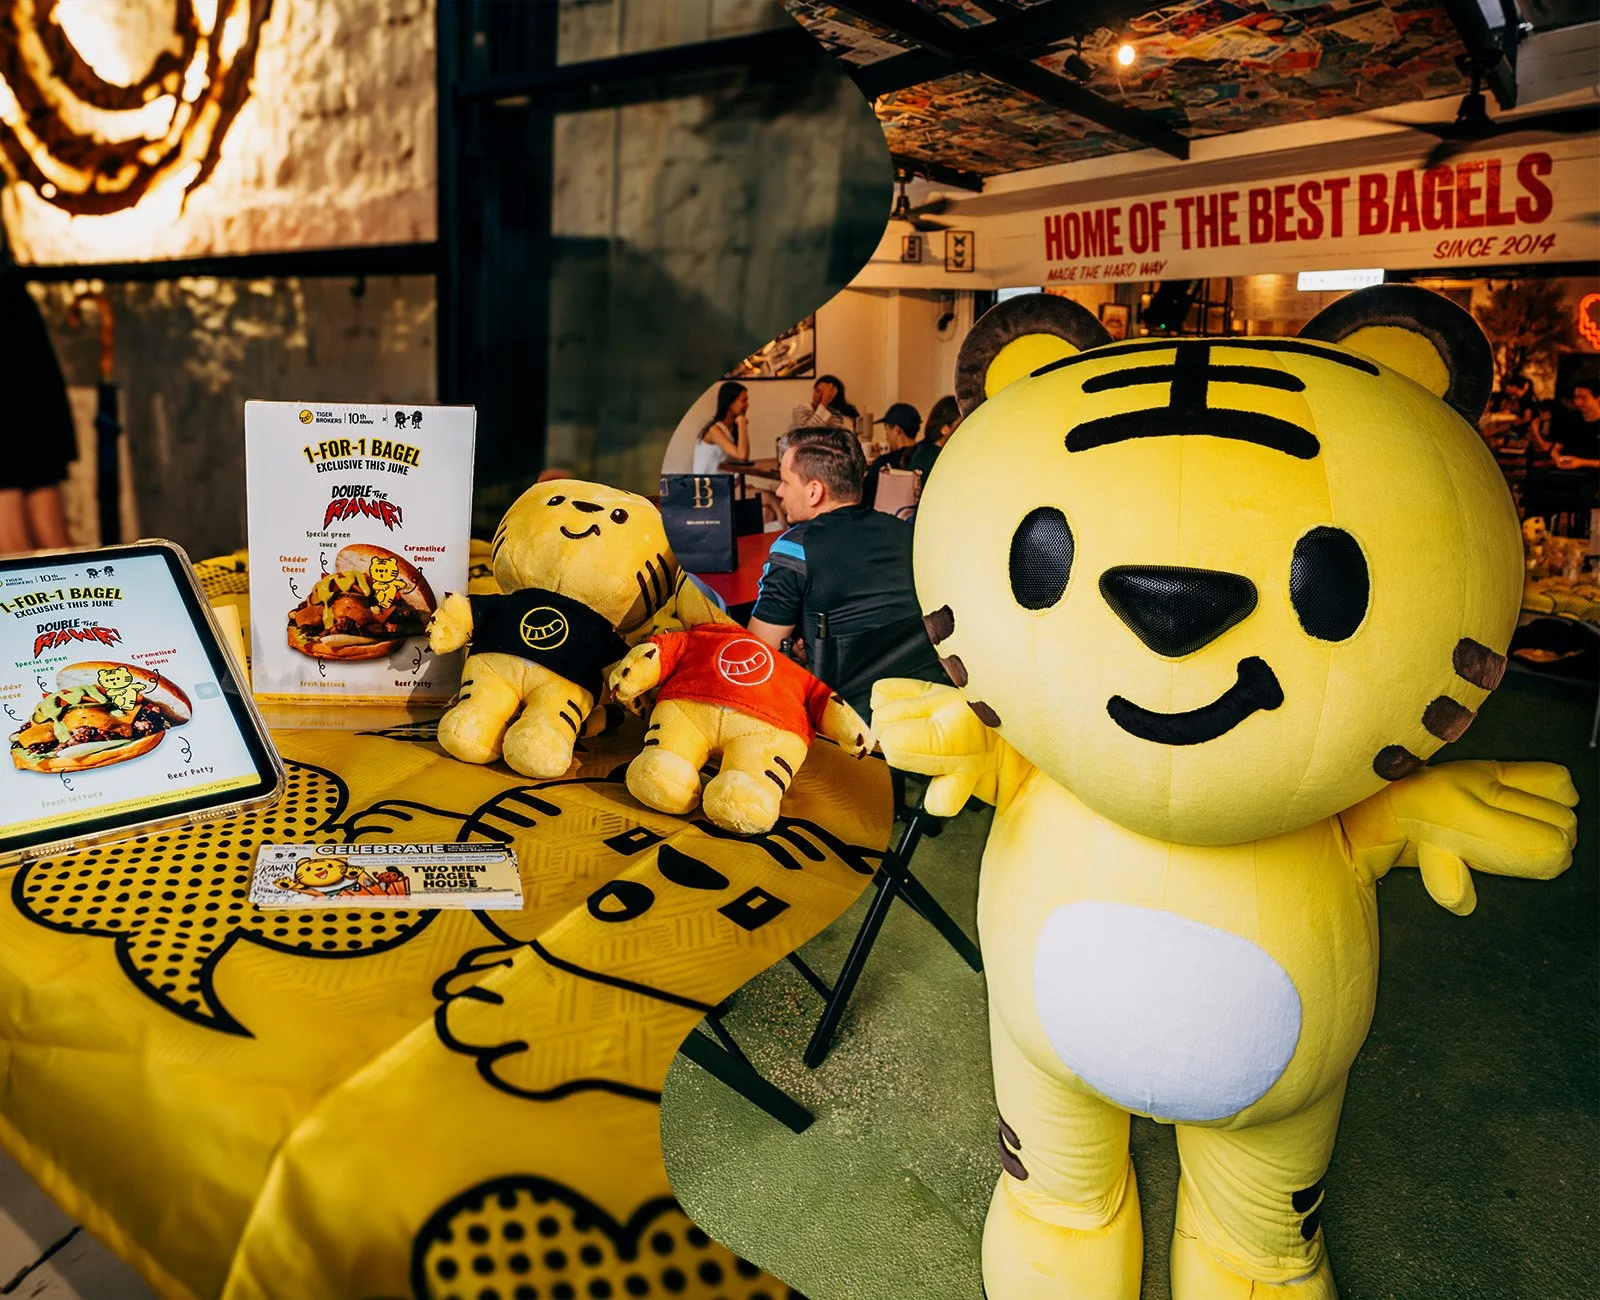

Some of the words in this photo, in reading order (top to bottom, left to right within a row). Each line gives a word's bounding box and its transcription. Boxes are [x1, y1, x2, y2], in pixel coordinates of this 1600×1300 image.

[1044, 206, 1123, 262] HOME
[1128, 201, 1167, 254] OF
[1175, 190, 1241, 250] THE
[1248, 177, 1351, 244] BEST
[1357, 151, 1554, 236] BAGELS
[1432, 236, 1496, 260] SINCE
[1499, 232, 1557, 256] 2014
[1047, 266, 1079, 282] MADE
[1080, 265, 1101, 280] THE
[1101, 262, 1138, 279] HARD
[1138, 259, 1169, 277] WAY
[303, 438, 366, 464] 1-FOR-1
[371, 438, 421, 467] BAGEL
[316, 459, 363, 474] EXCLUSIVE
[365, 460, 386, 472] THIS
[387, 462, 410, 476] JUNE
[331, 484, 373, 499] DOUBLE
[371, 490, 388, 501] THE
[322, 498, 403, 532] RAWR!
[305, 530, 329, 539] Special
[330, 531, 351, 539] green
[403, 544, 446, 553] Caramelised
[279, 555, 309, 564] Cheddar
[413, 555, 436, 563] Onions
[281, 565, 306, 573] Cheese
[0, 589, 65, 614] 1-FOR-1
[69, 587, 123, 600] BAGEL
[13, 602, 65, 619] EXCLUSIVE
[66, 600, 89, 610] THIS
[91, 600, 114, 608] JUNE
[36, 618, 81, 634] DOUBLE
[80, 619, 99, 628] THE
[33, 626, 123, 660] RAWR!
[131, 648, 177, 660] Caramelised
[15, 658, 43, 668] Special
[44, 655, 68, 664] green
[145, 658, 169, 667] Onions
[412, 680, 432, 688] Patty
[167, 769, 189, 781] Beef
[190, 765, 214, 776] Patty
[316, 843, 445, 855] CELEBRATE
[259, 863, 294, 875] RAWR!
[411, 865, 450, 873] TWO
[451, 865, 487, 873] MEN
[424, 872, 475, 880] BAGEL
[423, 879, 478, 888] HOUSE
